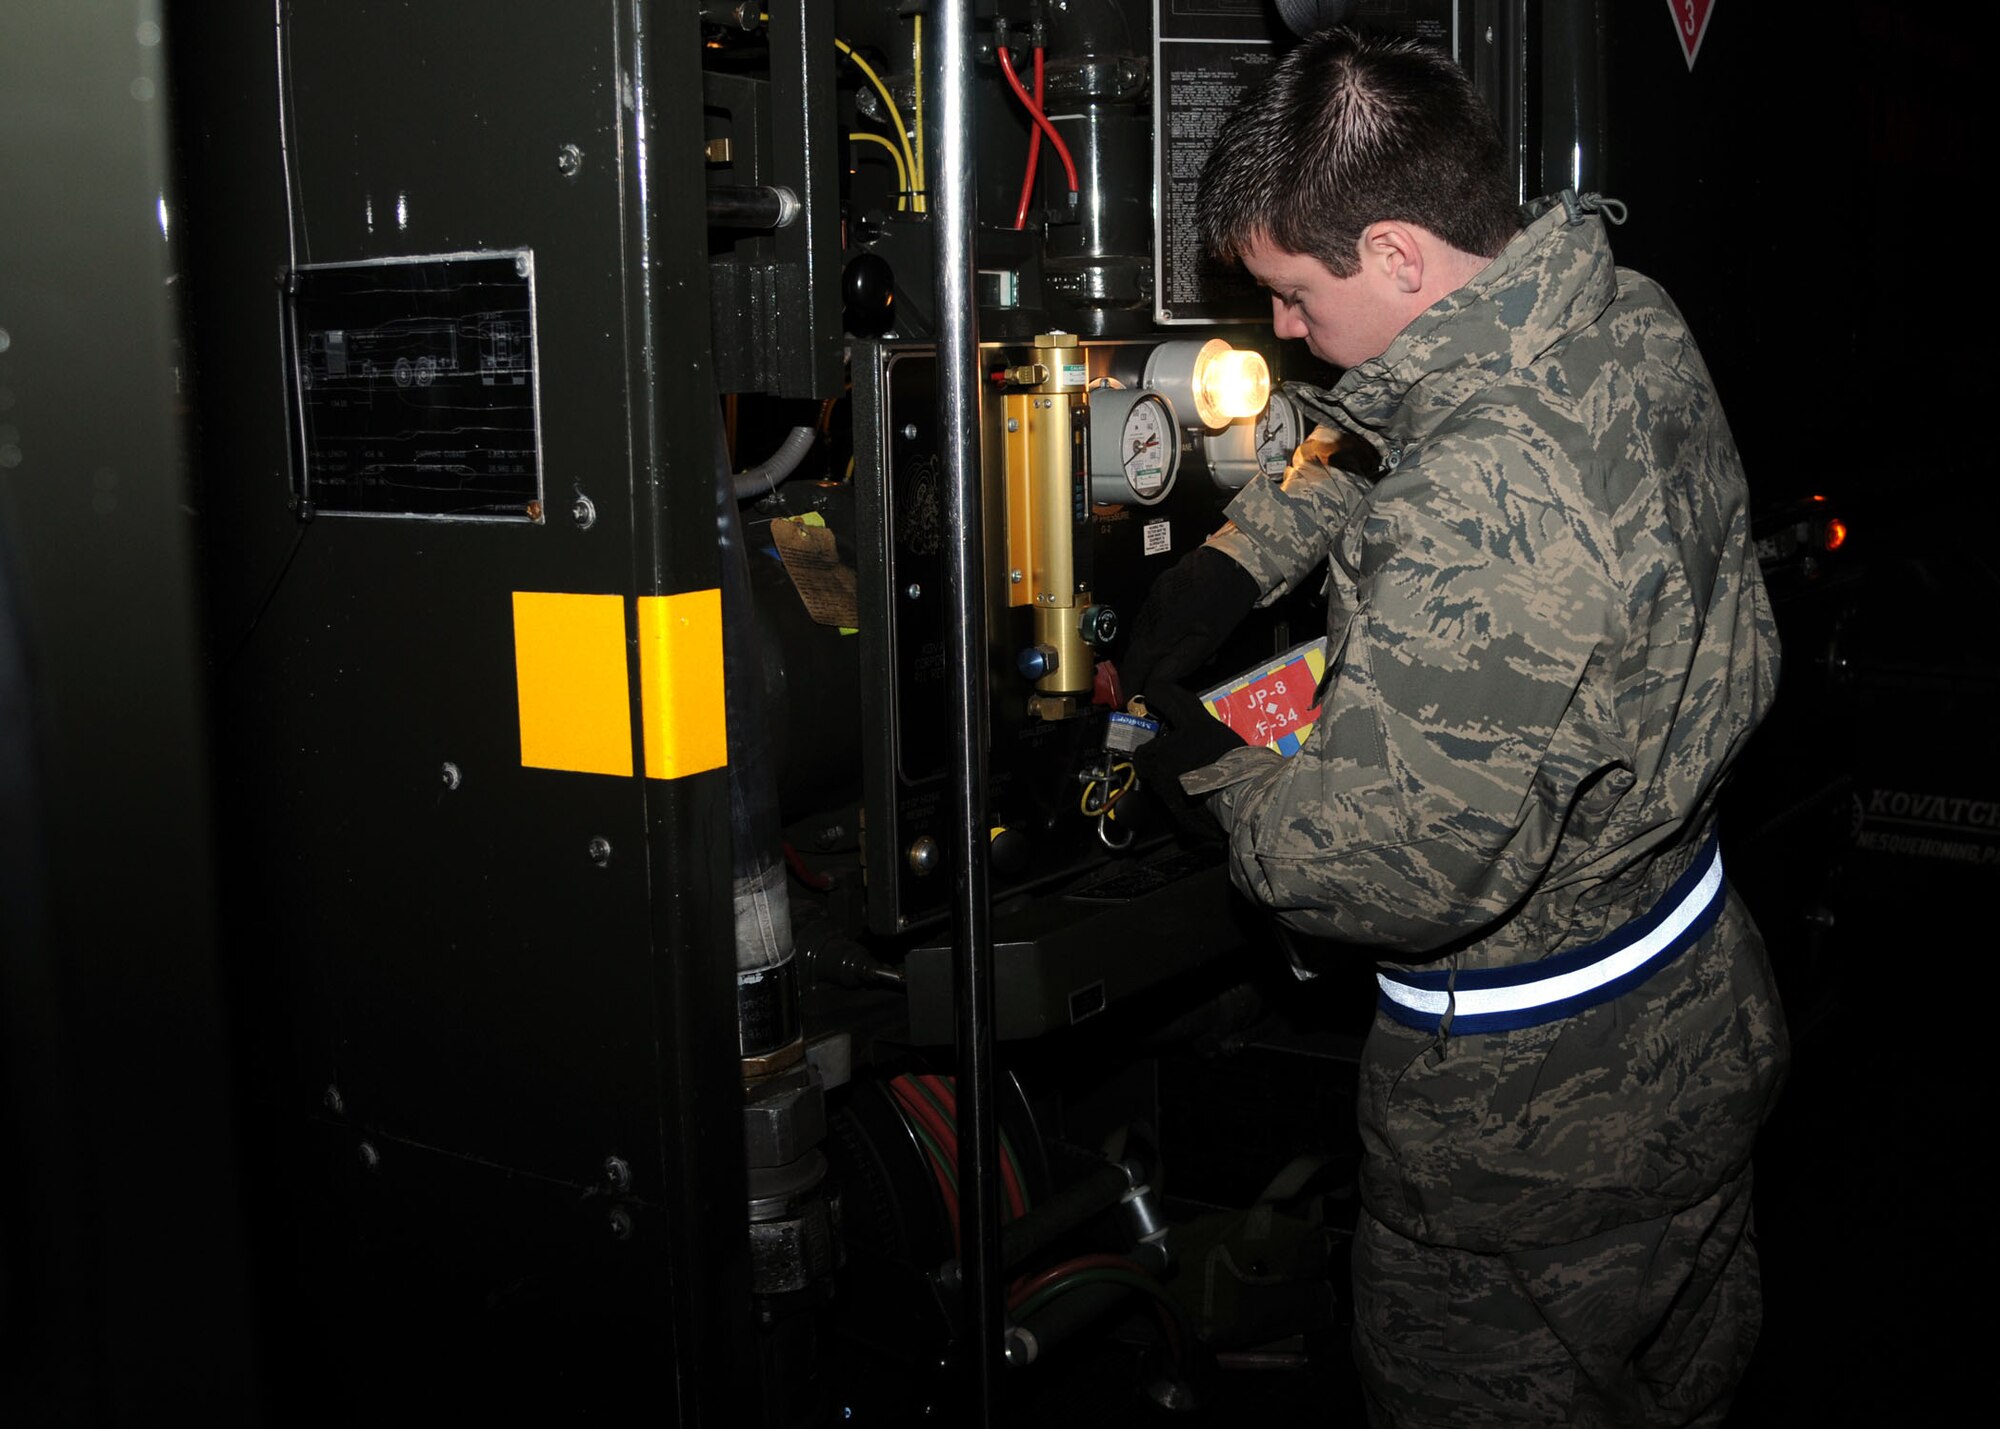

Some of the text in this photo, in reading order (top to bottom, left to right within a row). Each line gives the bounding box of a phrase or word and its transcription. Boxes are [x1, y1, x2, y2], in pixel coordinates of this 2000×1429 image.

[1685, 0, 1695, 36] 3
[1247, 680, 1287, 709] JP-8
[1258, 707, 1298, 737] F-34
